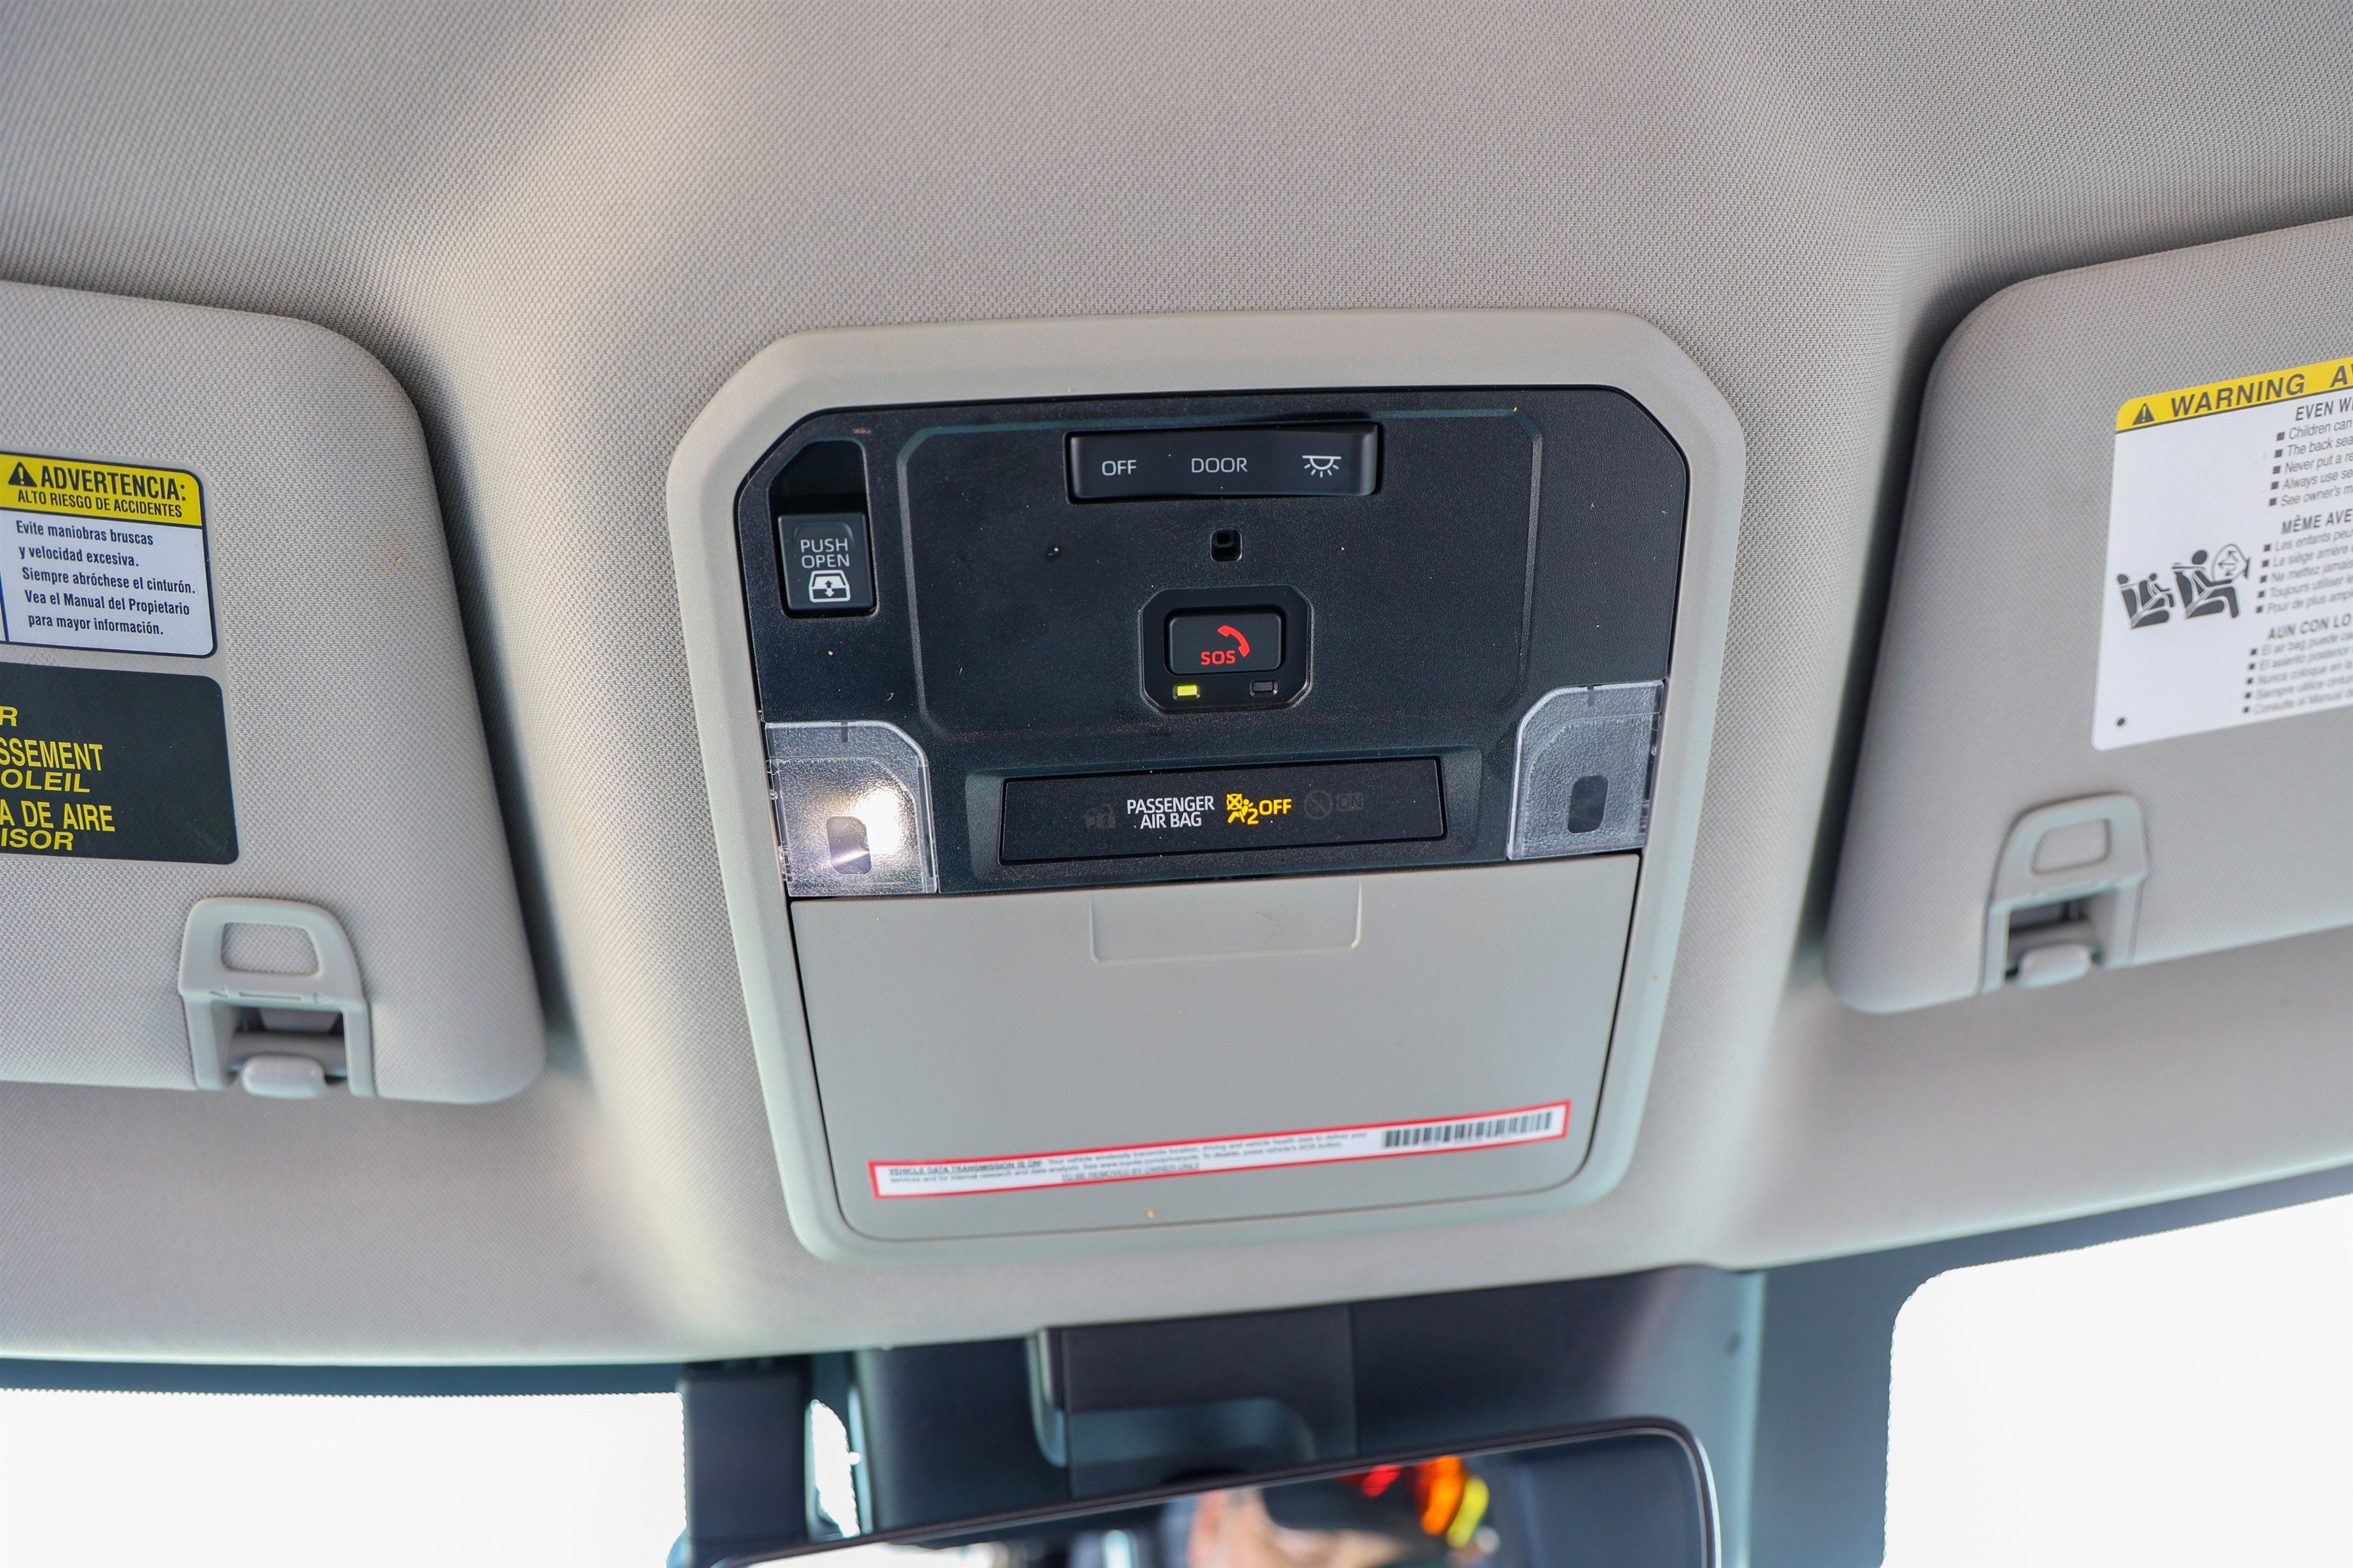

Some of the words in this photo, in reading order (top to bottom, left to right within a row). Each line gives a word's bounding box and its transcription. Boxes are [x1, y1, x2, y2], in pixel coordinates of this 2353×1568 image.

[2171, 373, 2305, 417] WARNING
[2329, 364, 2353, 388] A
[2296, 400, 2333, 421] EVEN
[2339, 397, 2353, 412] W
[2289, 423, 2331, 439] Children
[2334, 420, 2352, 431] can
[2288, 444, 2306, 457] The
[2309, 438, 2332, 452] back
[1101, 459, 1137, 476] OFF
[1191, 457, 1248, 473] DOOR
[2285, 459, 2315, 473] Never
[2316, 454, 2333, 470] put
[2335, 454, 2342, 464] a
[41, 465, 187, 501] ADVERTENCIA:
[2282, 476, 2317, 489] Always
[2321, 472, 2338, 483] use
[18, 490, 47, 504] ALTO
[51, 493, 92, 509] RIESGO
[97, 497, 110, 511] DE
[114, 499, 182, 517] ACCIDENTES
[2281, 495, 2300, 506] See
[16, 520, 44, 535] Evite
[48, 525, 107, 541] maniobras
[110, 529, 154, 545] bruscas
[800, 538, 848, 553] PUSH
[19, 546, 26, 559] y
[29, 546, 83, 562] velocidad
[87, 553, 139, 567] excesiva.
[801, 554, 850, 568] OPEN
[22, 567, 68, 585] Siempre
[72, 573, 129, 588] abróchese
[133, 577, 143, 589] el
[147, 580, 195, 594] cinturón.
[25, 590, 47, 604] Vea
[50, 592, 60, 605] el
[64, 593, 105, 608] Manual
[109, 597, 125, 611] del
[129, 599, 190, 615] Propietario
[28, 614, 53, 627] para
[57, 617, 91, 631] mayor
[94, 618, 164, 635] información.
[2300, 617, 2329, 635] CON
[1201, 650, 1236, 665] SOS
[0, 706, 18, 727] R
[0, 736, 103, 771] SSEMENT
[1, 768, 90, 793] OLEIL
[1127, 795, 1215, 814] PASSENGER
[1259, 798, 1292, 816] OFF
[0, 799, 15, 826] A
[21, 801, 54, 828] DE
[63, 803, 115, 832] AIRE
[1140, 813, 1167, 829] AIR
[1170, 812, 1202, 828] BAG
[1, 828, 74, 851] ISOR
